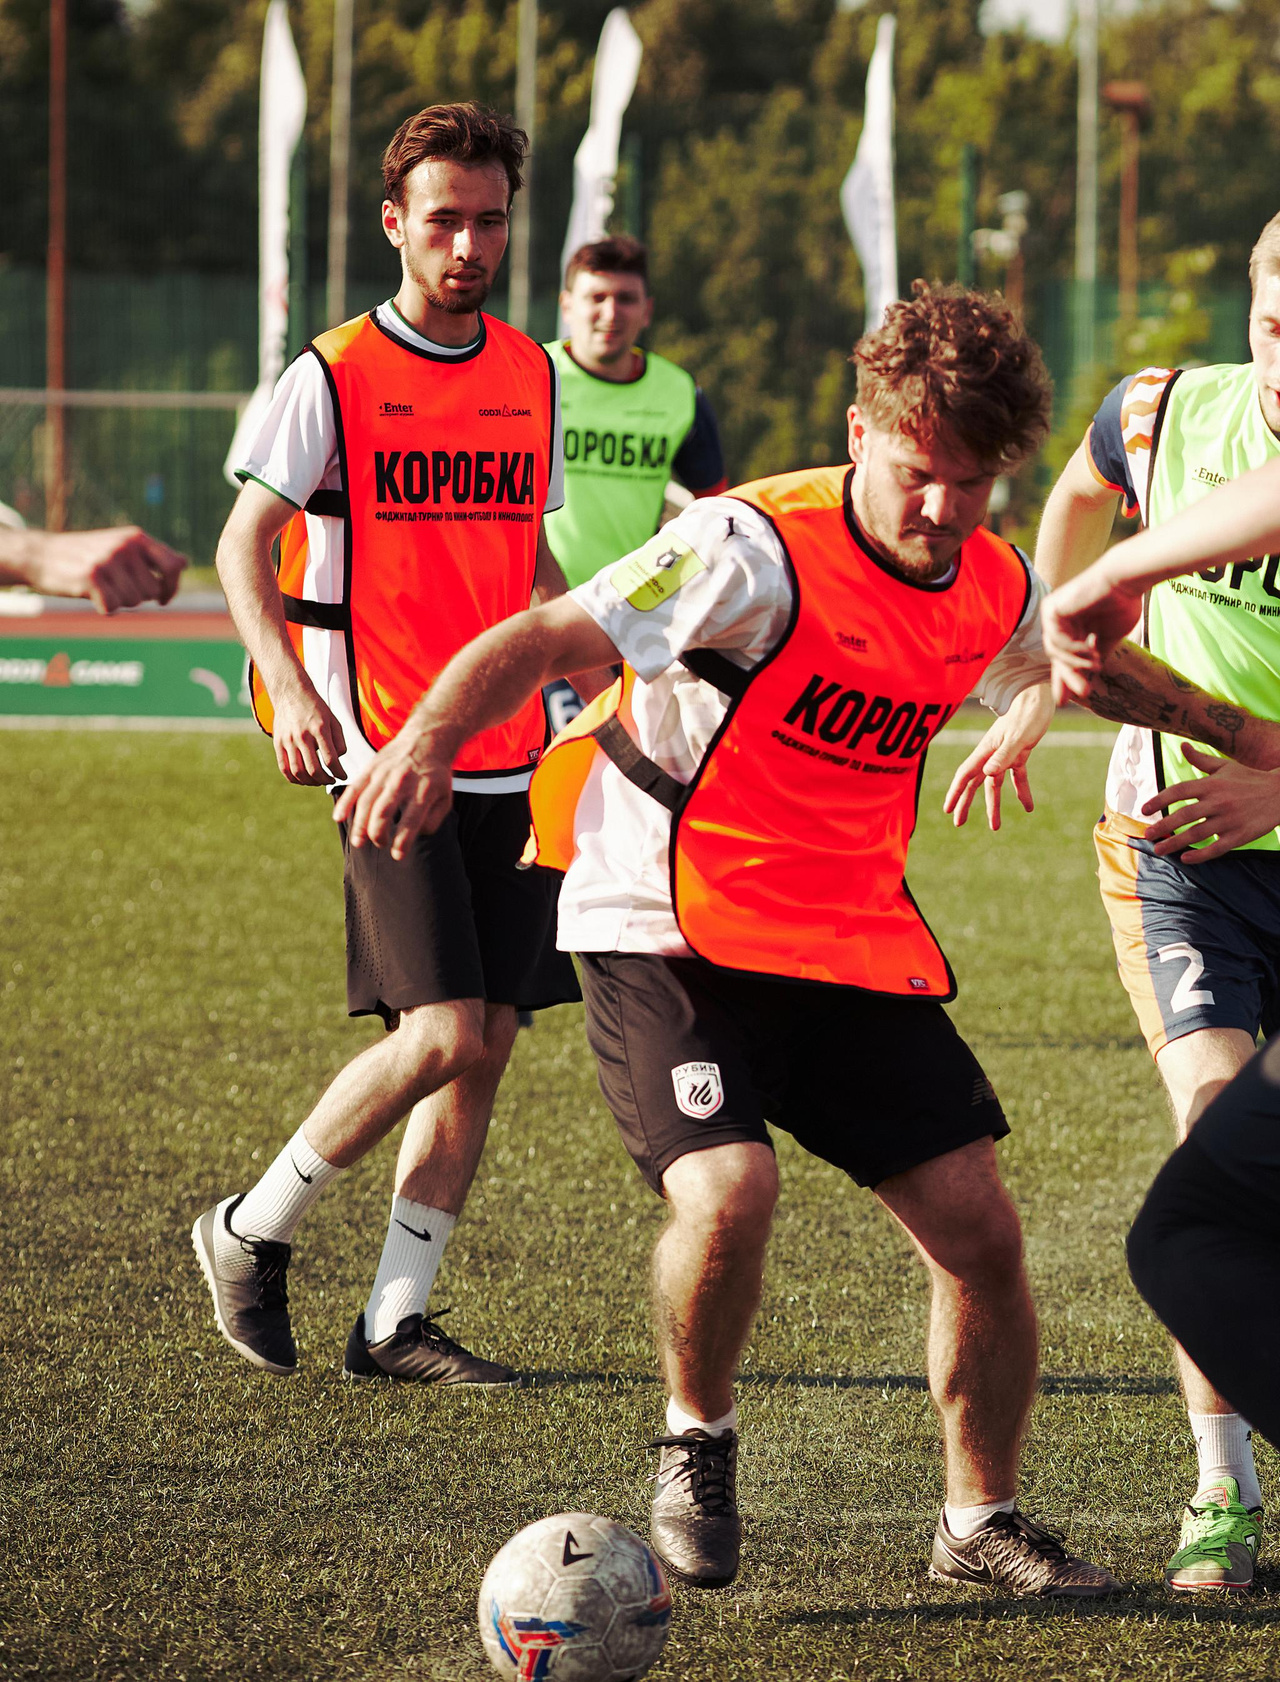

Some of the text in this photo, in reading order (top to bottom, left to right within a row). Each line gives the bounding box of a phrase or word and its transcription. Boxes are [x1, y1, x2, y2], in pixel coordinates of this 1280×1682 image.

[384, 402, 413, 412] Enter
[564, 429, 668, 468] ОРОБКА
[374, 451, 535, 505] КОРОБКА
[1198, 467, 1229, 485] Ente
[1167, 579, 1242, 609] ИДЖИТАЛ-ТУРНИР
[1244, 601, 1257, 613] ПО
[1157, 942, 1216, 1014] 2
